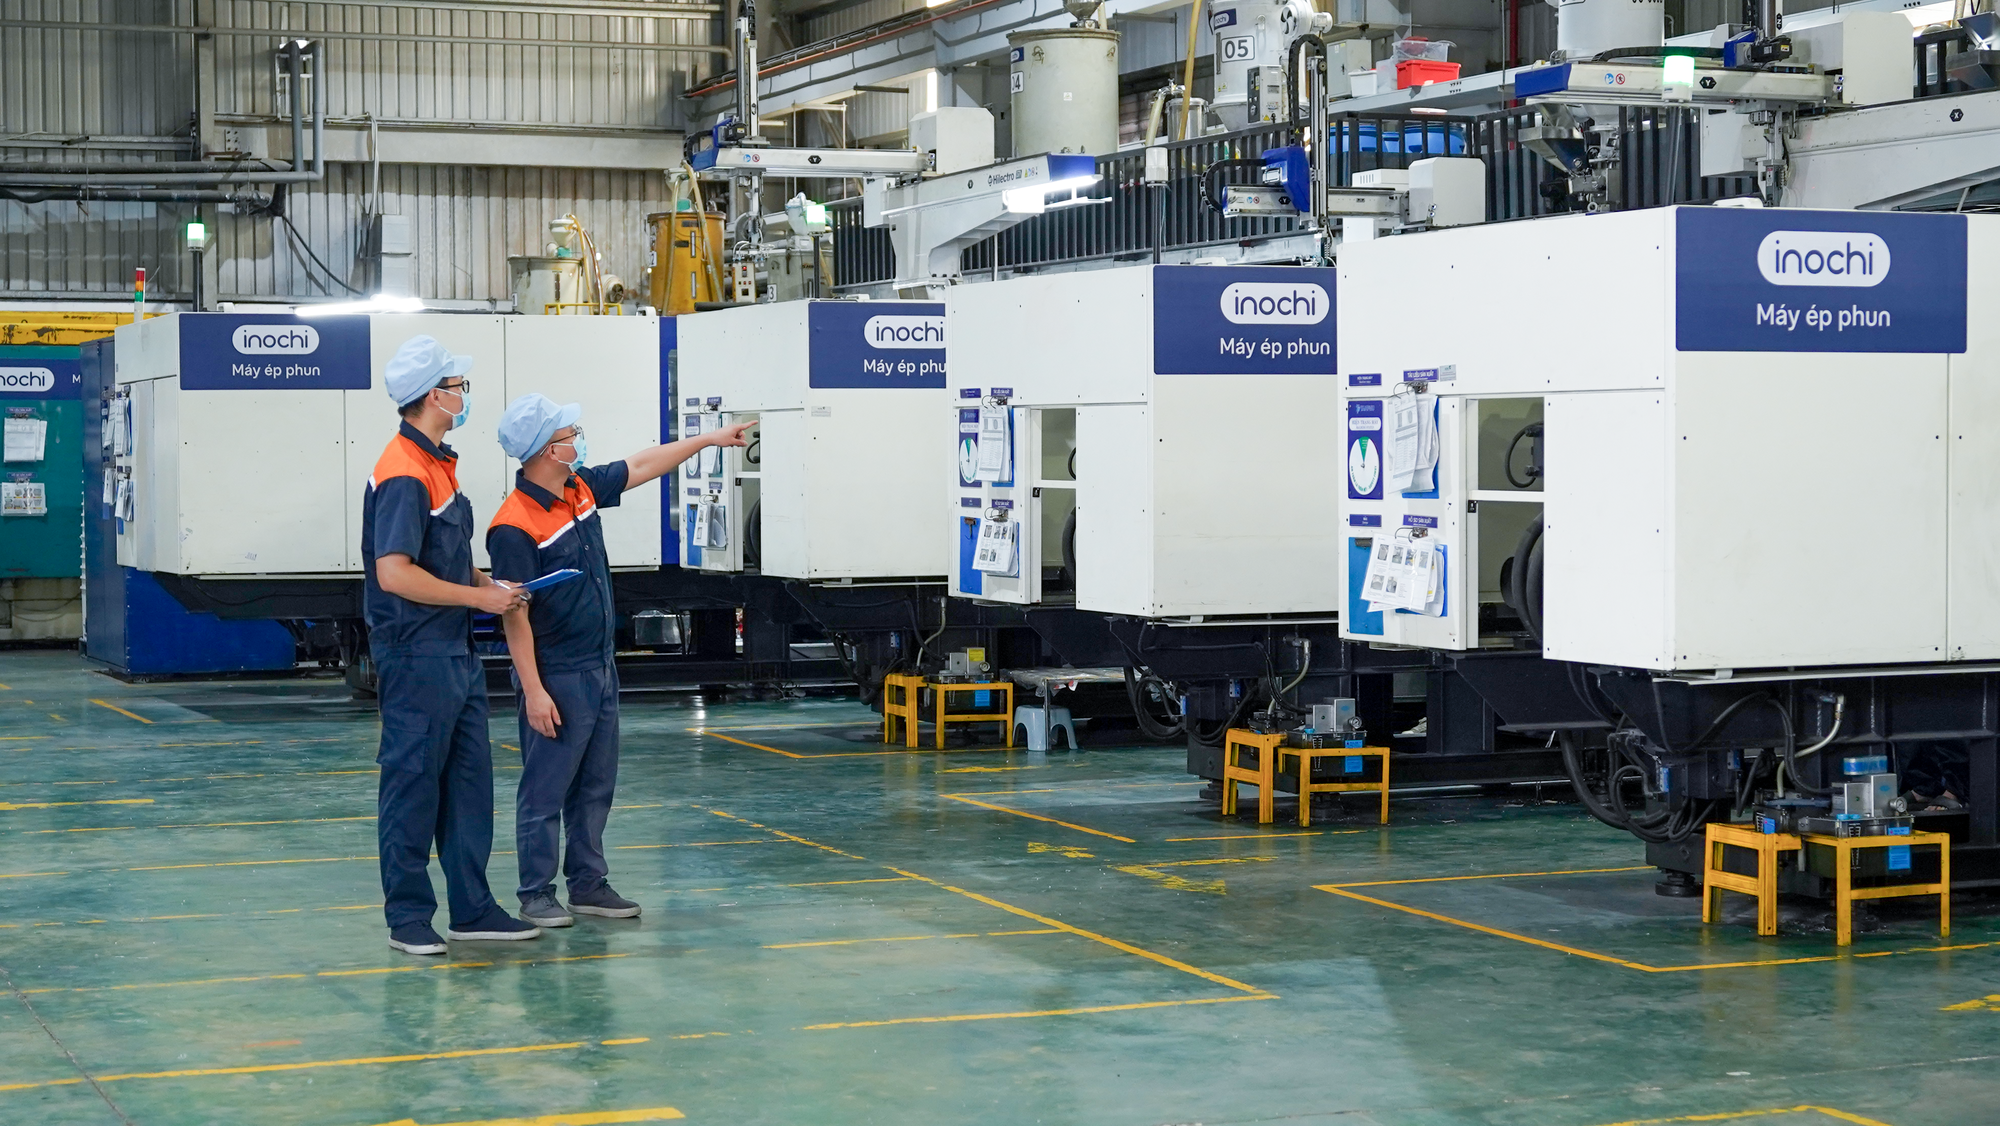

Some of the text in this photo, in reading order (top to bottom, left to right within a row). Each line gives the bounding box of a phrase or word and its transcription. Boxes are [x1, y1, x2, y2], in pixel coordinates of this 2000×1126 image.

[1224, 39, 1249, 59] 05
[1011, 74, 1021, 91] 4
[1775, 239, 1873, 276] inochi
[1234, 288, 1316, 316] inochi
[1756, 303, 1891, 332] Máy ép phun
[243, 329, 309, 349] inochi
[876, 320, 944, 342] inochi
[1220, 337, 1330, 359] Máy ép phun
[232, 363, 321, 379] Máy ép phun
[863, 358, 946, 377] Máy ép phu
